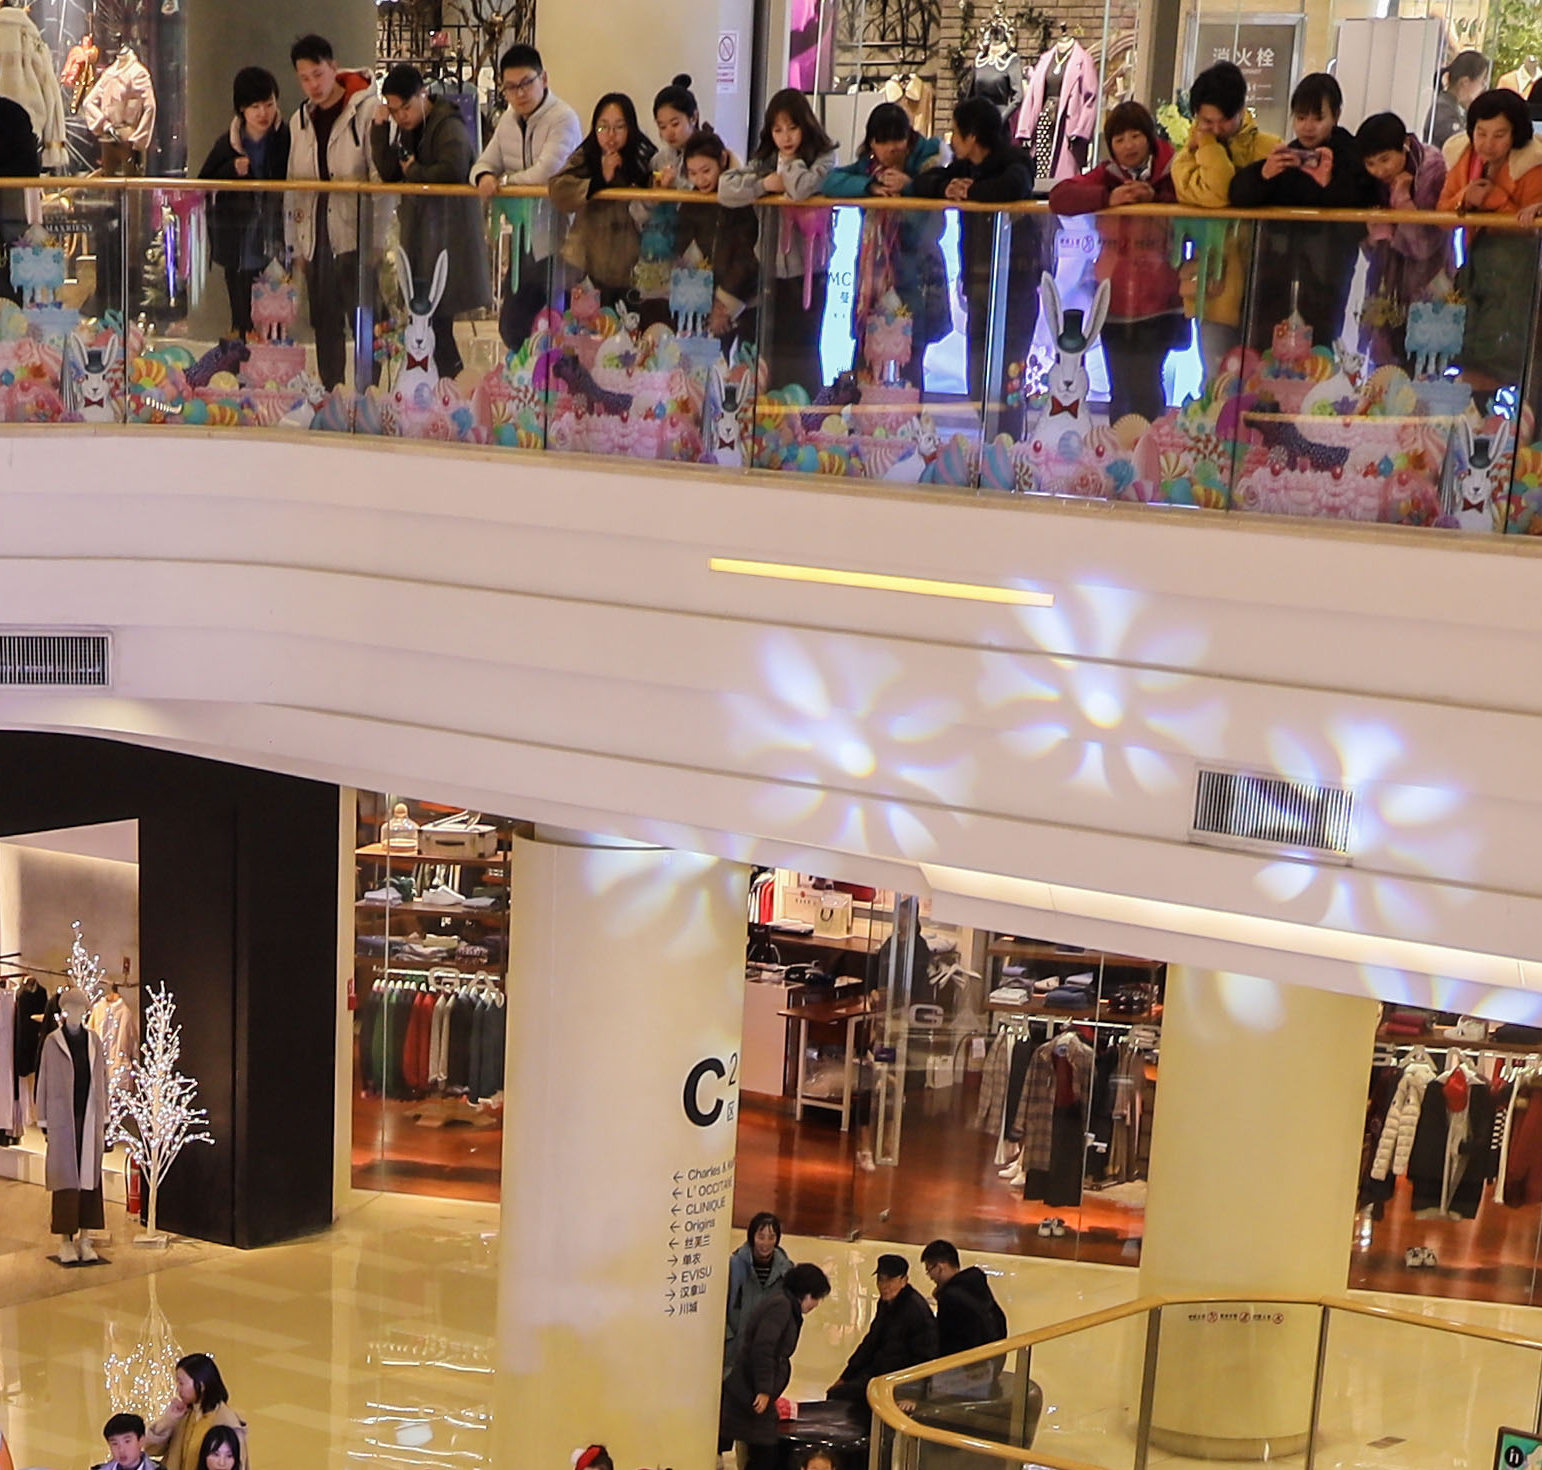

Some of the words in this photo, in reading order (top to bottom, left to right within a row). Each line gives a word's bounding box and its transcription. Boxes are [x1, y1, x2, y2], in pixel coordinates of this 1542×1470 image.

[687, 1163, 721, 1181] Charles
[685, 1196, 726, 1216] CLINIQUE
[684, 1218, 716, 1233] Origins
[681, 1266, 713, 1283] EVISU
